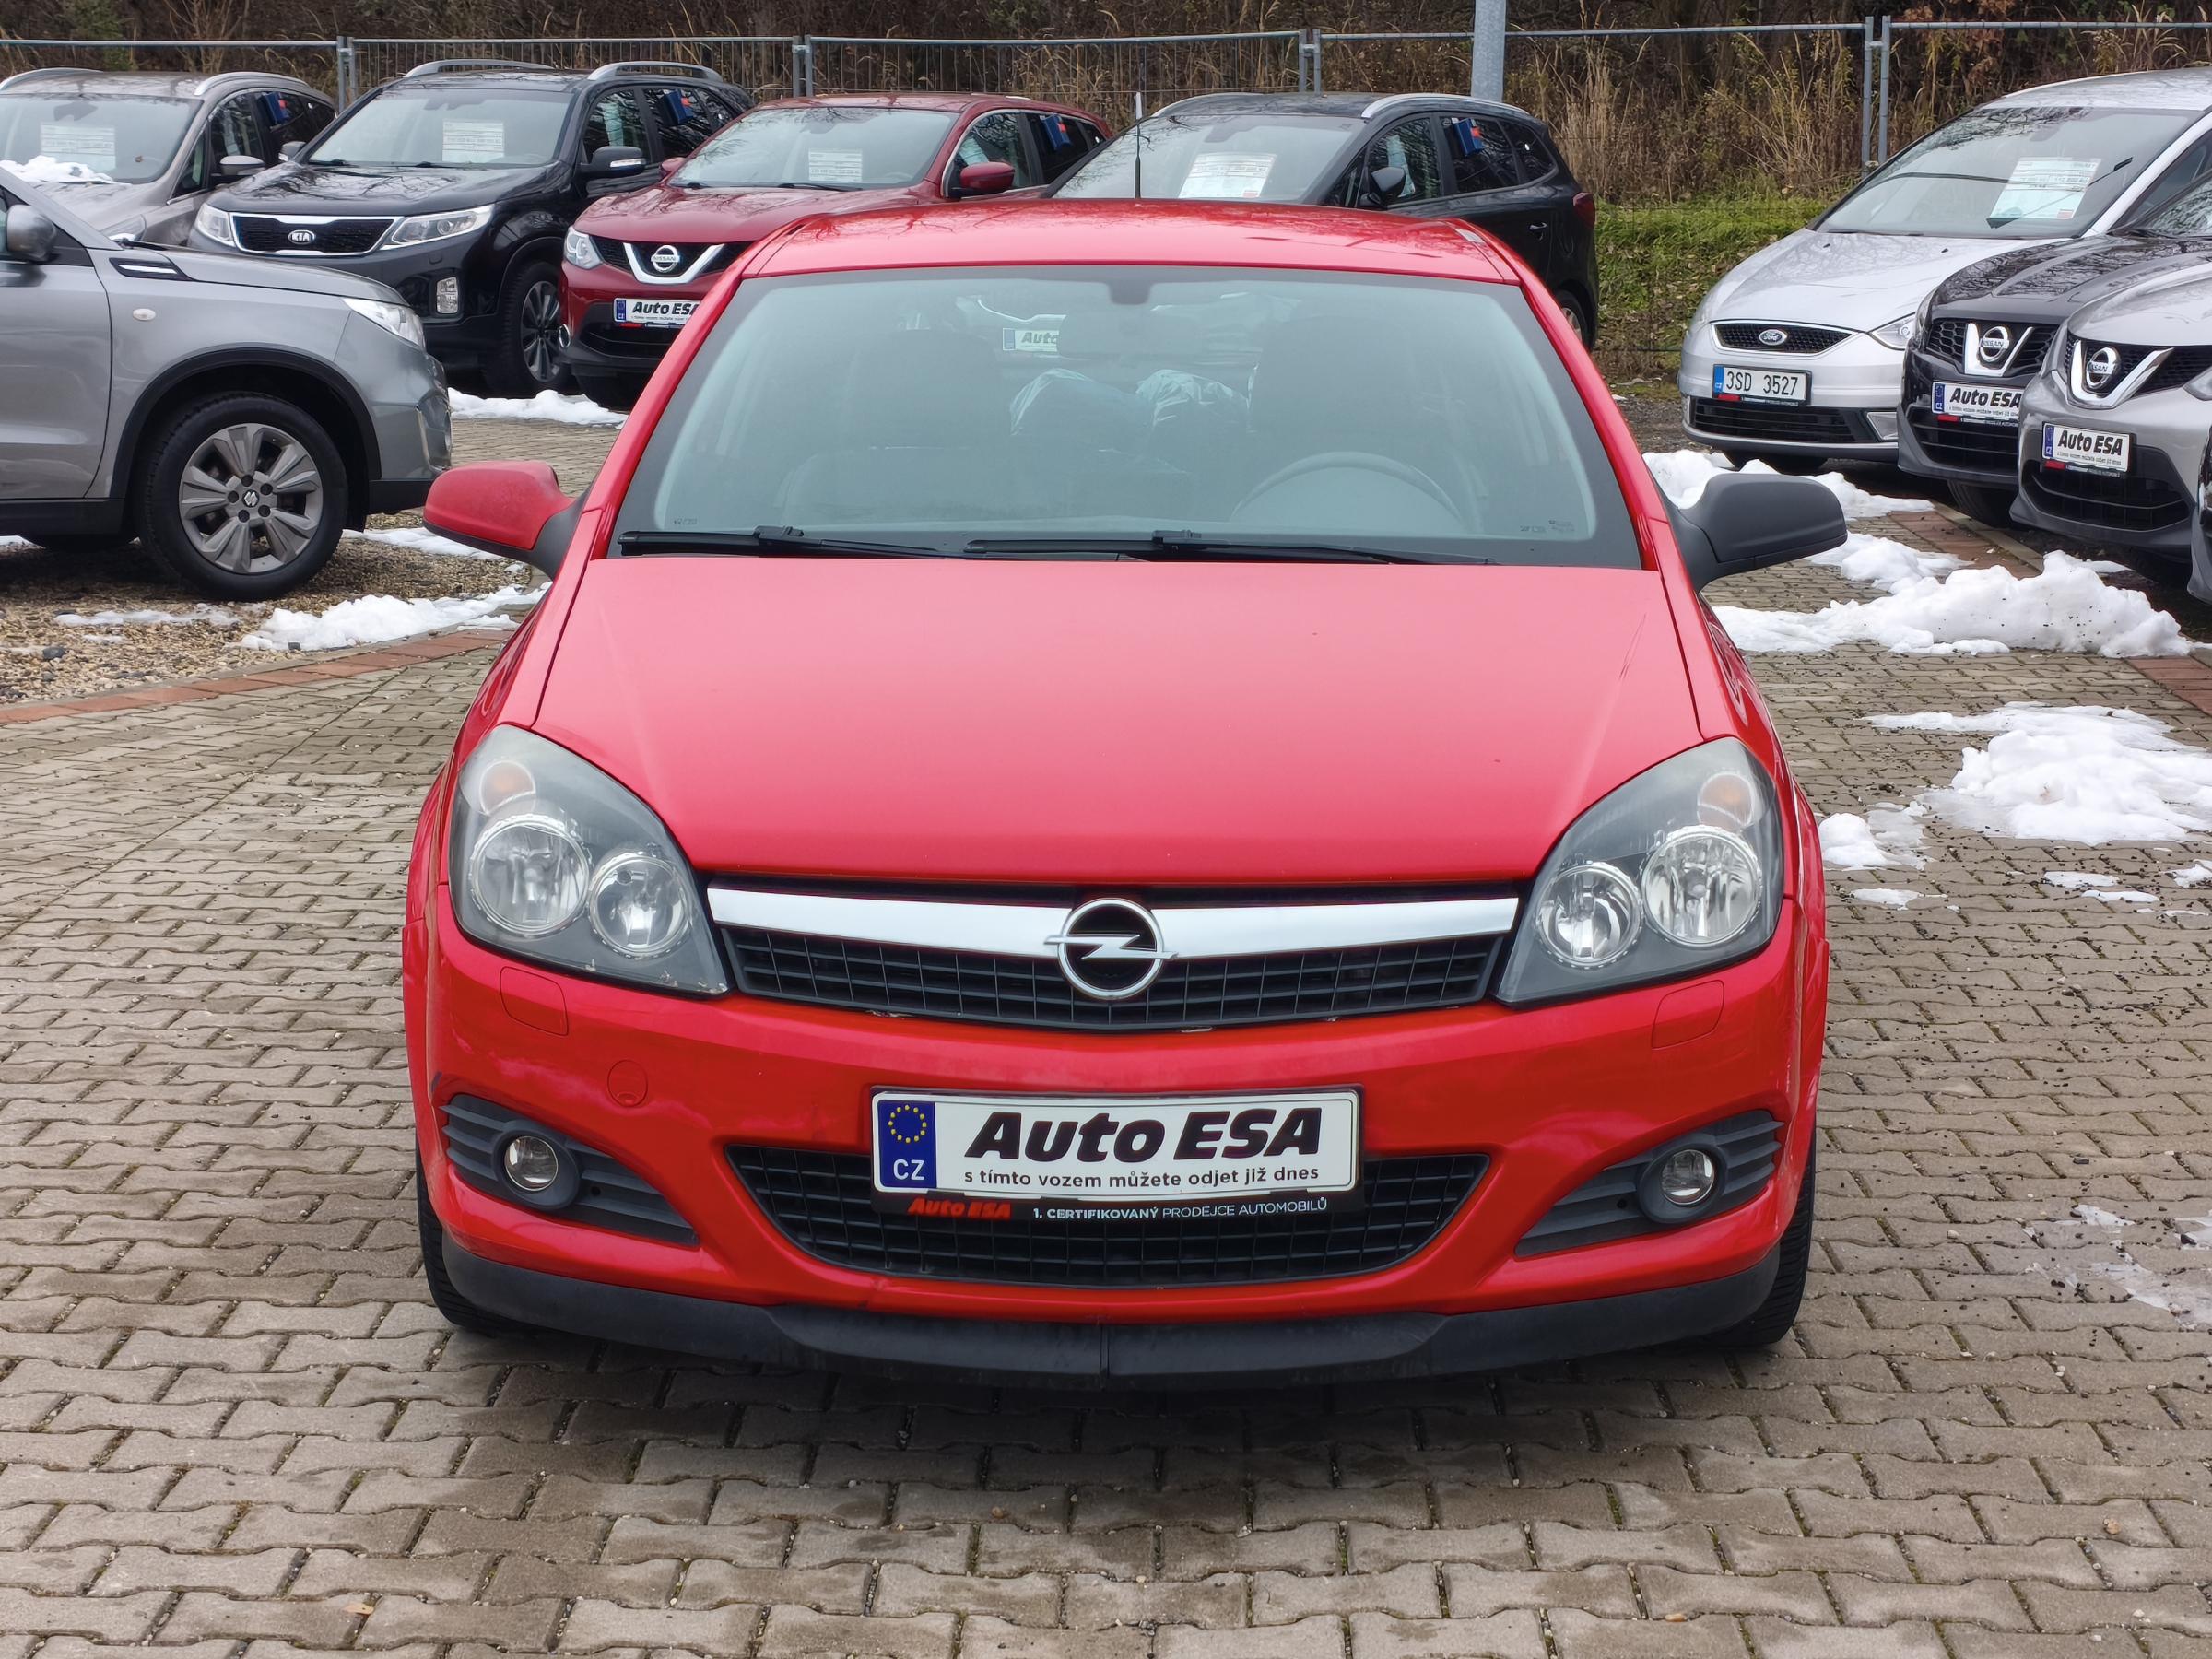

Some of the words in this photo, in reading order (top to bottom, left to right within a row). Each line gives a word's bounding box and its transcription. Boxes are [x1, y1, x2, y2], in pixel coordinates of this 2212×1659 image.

[291, 231, 312, 242] KIA
[632, 302, 670, 314] Auto
[1726, 371, 1752, 392] 3SD
[1763, 374, 1798, 396] 3527
[1950, 388, 1989, 406] Auto
[2057, 430, 2093, 452] Auto
[2094, 436, 2124, 456] ESA
[964, 1112, 1165, 1163] Auto
[1173, 1107, 1322, 1159] ESA
[893, 1159, 925, 1181] CZ
[964, 1171, 973, 1182] s
[980, 1169, 1031, 1185] tímto
[1038, 1174, 1101, 1188] vozem
[1109, 1171, 1181, 1188] můžete
[1188, 1170, 1239, 1187] odjet
[1244, 1167, 1267, 1185] již
[1273, 1166, 1319, 1181] dnes
[908, 1197, 966, 1217] Auto
[968, 1201, 1011, 1220] ESA
[1033, 1207, 1042, 1218] 1.
[1047, 1206, 1159, 1219] CERTIFIKOVANÝ
[1162, 1204, 1235, 1218] PRODEJCE
[1239, 1196, 1327, 1215] AUTOMOBILŮ
